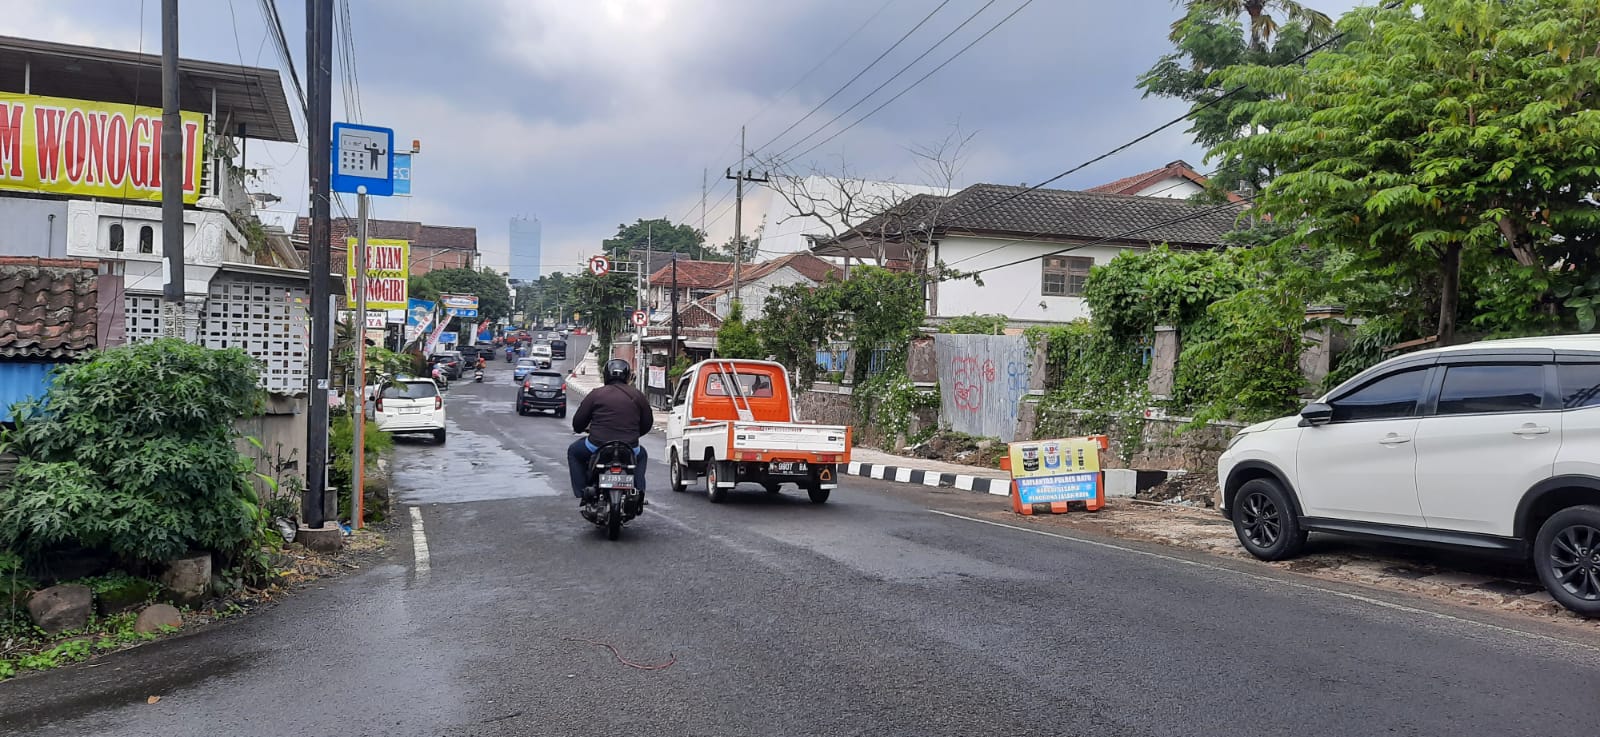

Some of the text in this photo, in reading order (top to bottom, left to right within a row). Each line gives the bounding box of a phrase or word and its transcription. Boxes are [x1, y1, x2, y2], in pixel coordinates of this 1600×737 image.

[34, 108, 197, 190] WONOGII
[375, 246, 402, 270] AYAM
[351, 278, 404, 301] WNOGIRI
